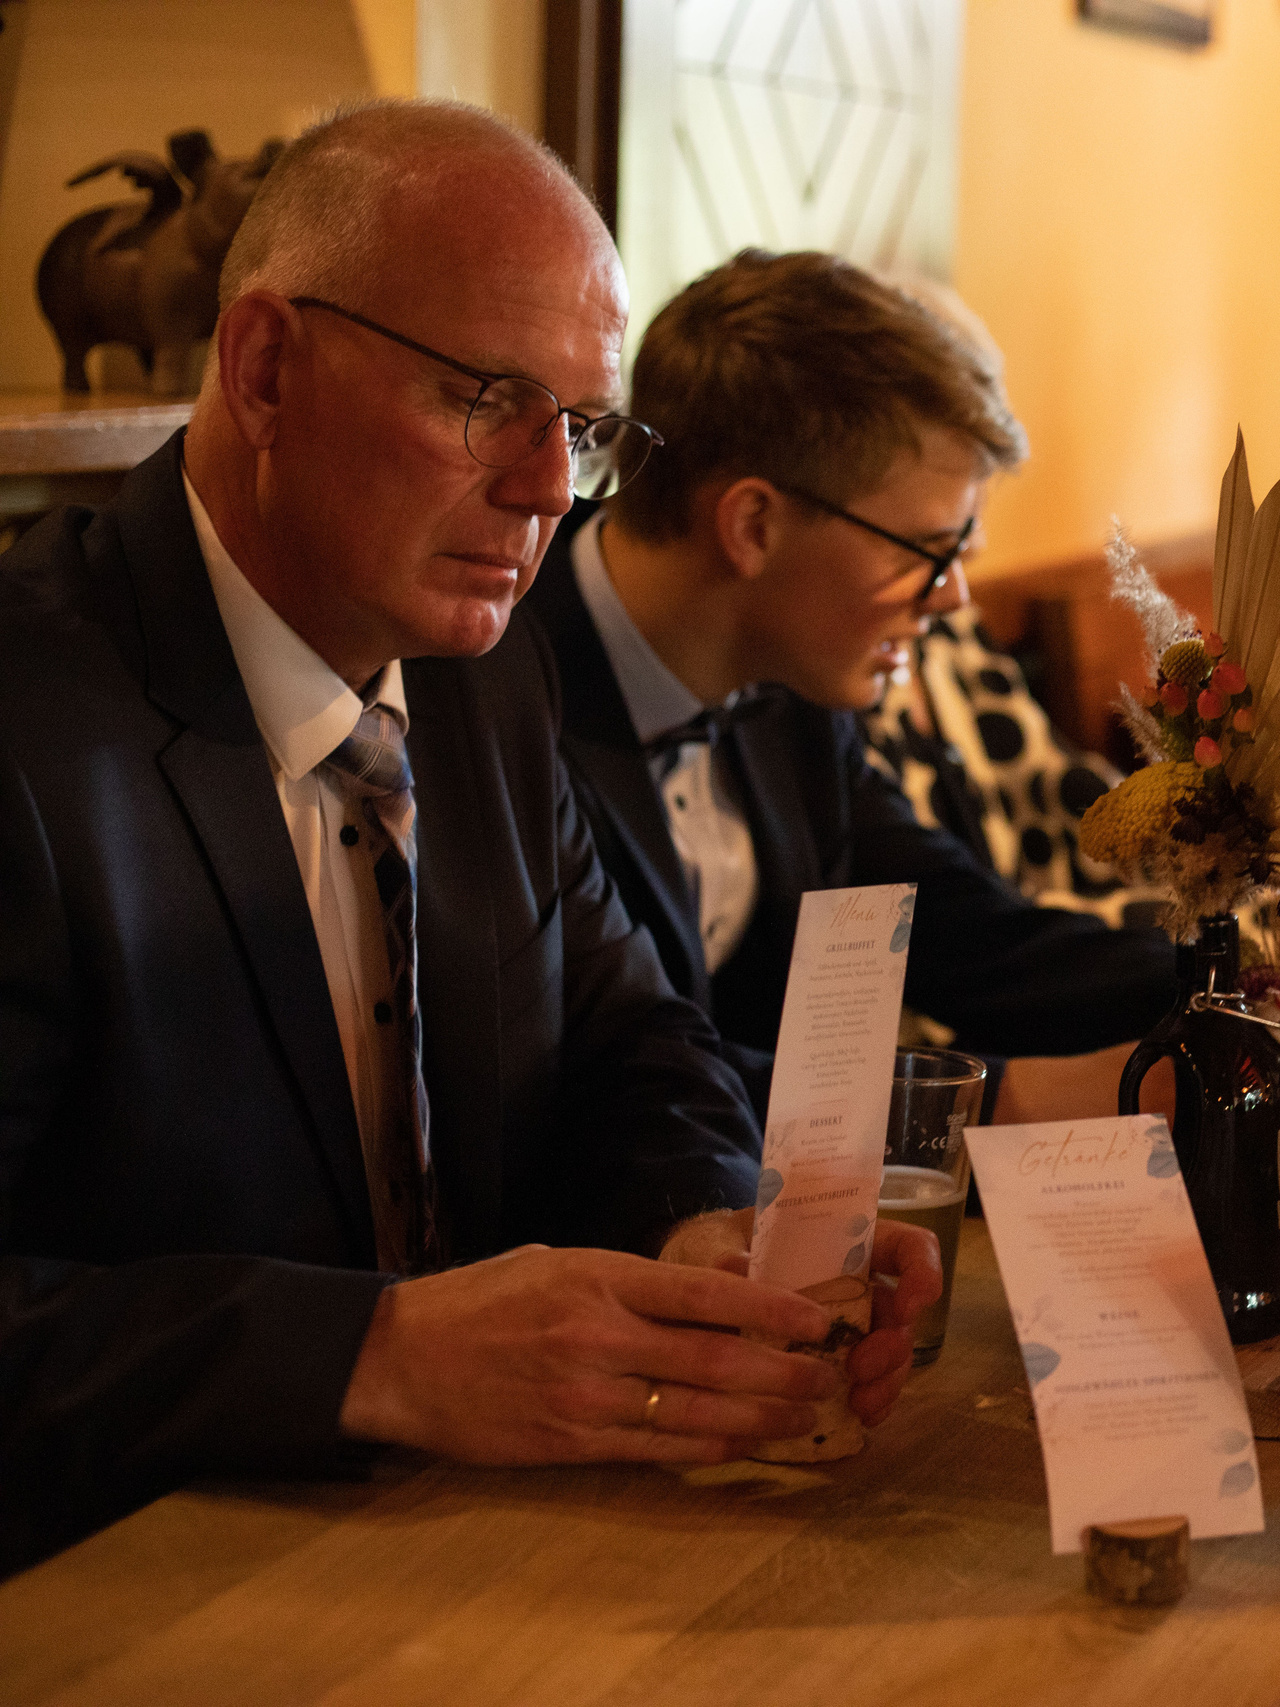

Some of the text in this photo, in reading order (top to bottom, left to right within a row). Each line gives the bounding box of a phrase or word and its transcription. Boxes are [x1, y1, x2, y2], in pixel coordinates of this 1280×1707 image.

[825, 940, 876, 952] GRILLBUFFET
[809, 1115, 843, 1128] DESSERT
[775, 1186, 860, 1209] MITTERNACHTSBUFFET
